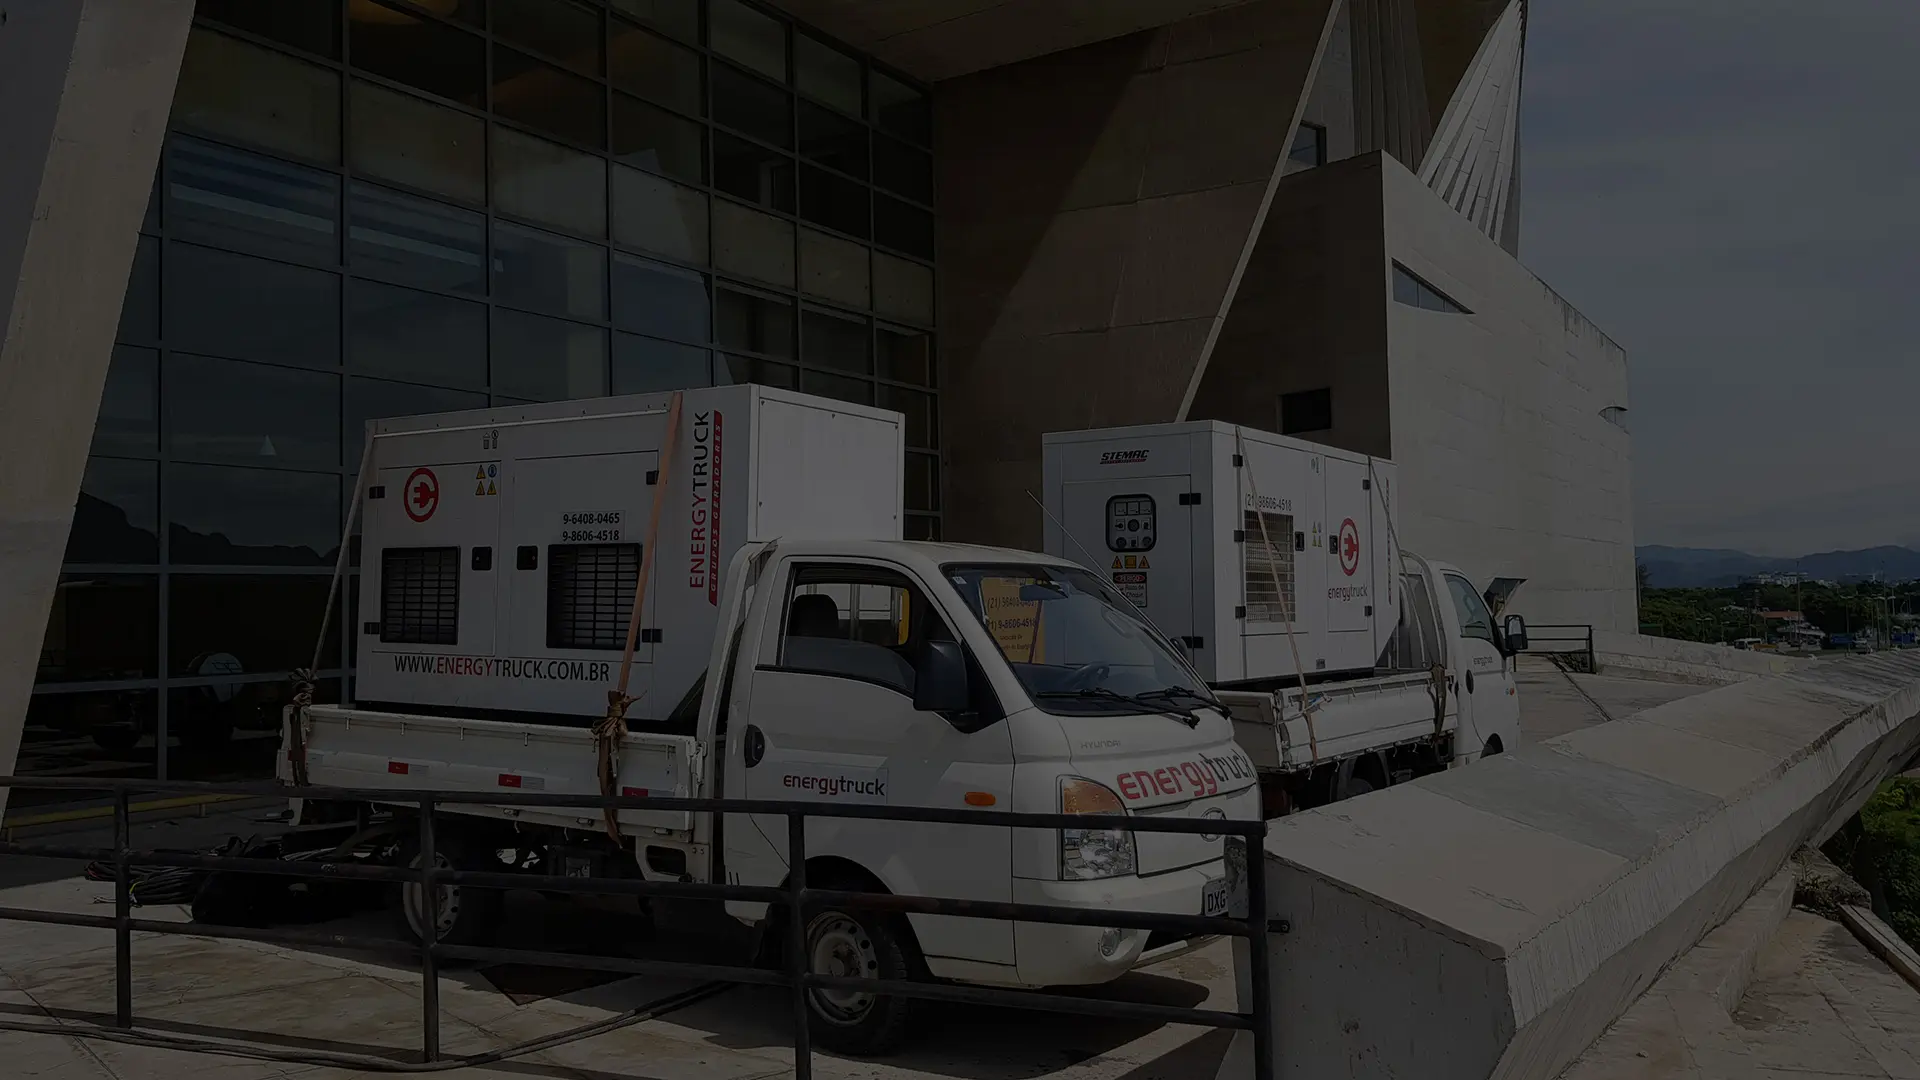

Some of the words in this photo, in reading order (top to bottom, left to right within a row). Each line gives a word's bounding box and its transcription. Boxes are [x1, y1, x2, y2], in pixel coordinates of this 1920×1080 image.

[1101, 450, 1150, 460] STEMAC
[713, 424, 721, 520] GERADORES
[690, 411, 709, 588] ENERGYTRUCK
[563, 512, 620, 525] 9-6408-0465
[562, 529, 620, 542] 9-8606-4518
[711, 528, 719, 592] GRUPOS
[1328, 584, 1368, 601] energytruck
[394, 655, 610, 682] WWW.ENERGYTRUCK.COM.BR
[1081, 739, 1121, 750] HYUNDAI
[783, 774, 885, 796] energytruck
[1116, 748, 1255, 800] energytruck
